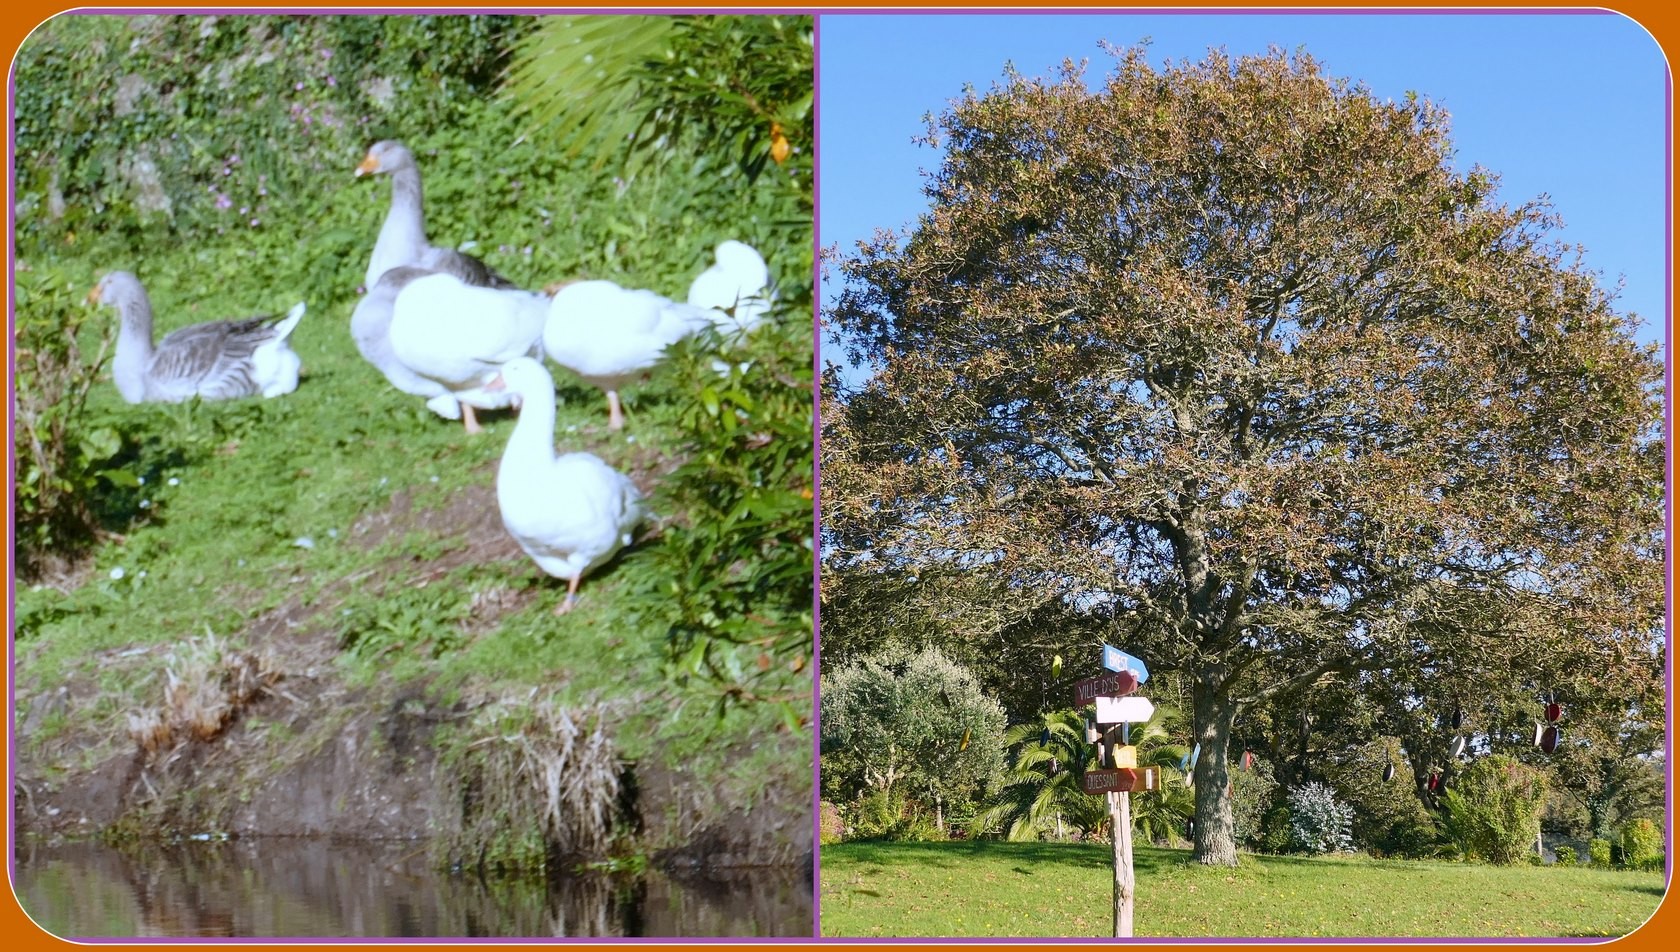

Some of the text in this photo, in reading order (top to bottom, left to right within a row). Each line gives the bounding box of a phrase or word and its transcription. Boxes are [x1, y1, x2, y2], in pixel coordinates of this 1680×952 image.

[1078, 675, 1120, 701] VILLE D'YS
[1087, 772, 1118, 790] OUESSANT
